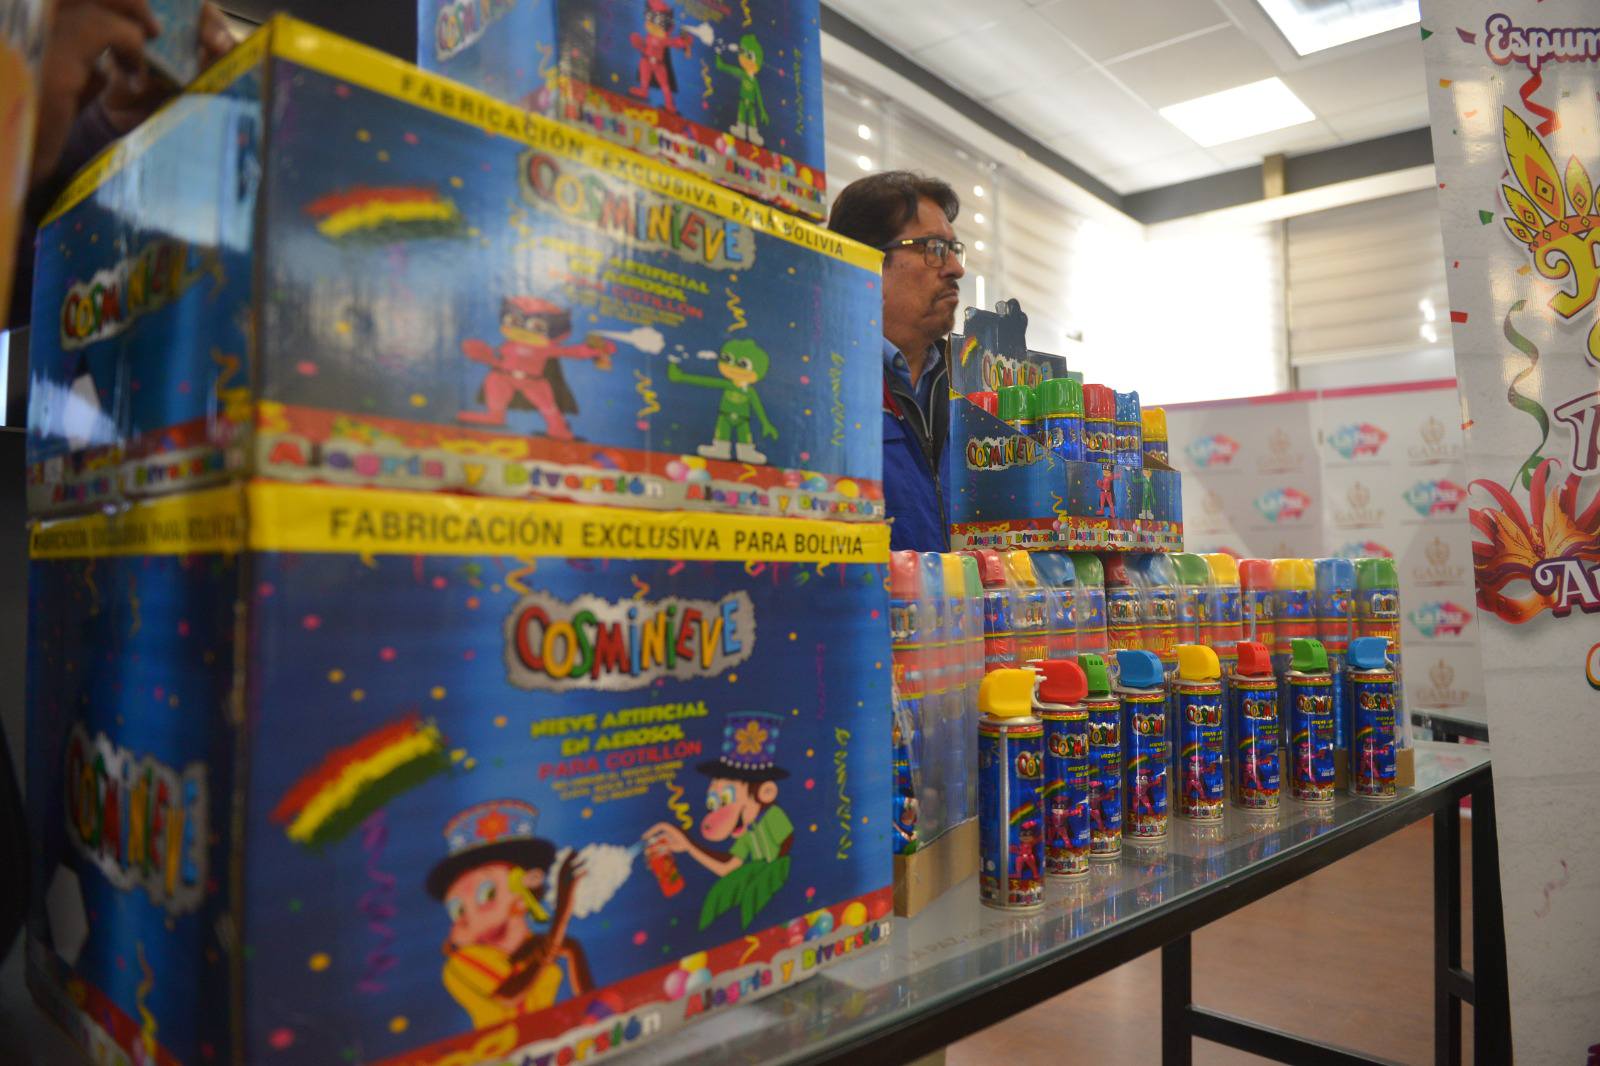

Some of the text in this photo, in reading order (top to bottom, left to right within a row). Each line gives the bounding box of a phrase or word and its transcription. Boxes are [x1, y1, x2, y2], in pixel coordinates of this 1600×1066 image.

[330, 507, 864, 556] FABRICACIÓN EXCLUSIVA PARA BOLIVIA
[602, 701, 708, 729] ARTIFICIAL
